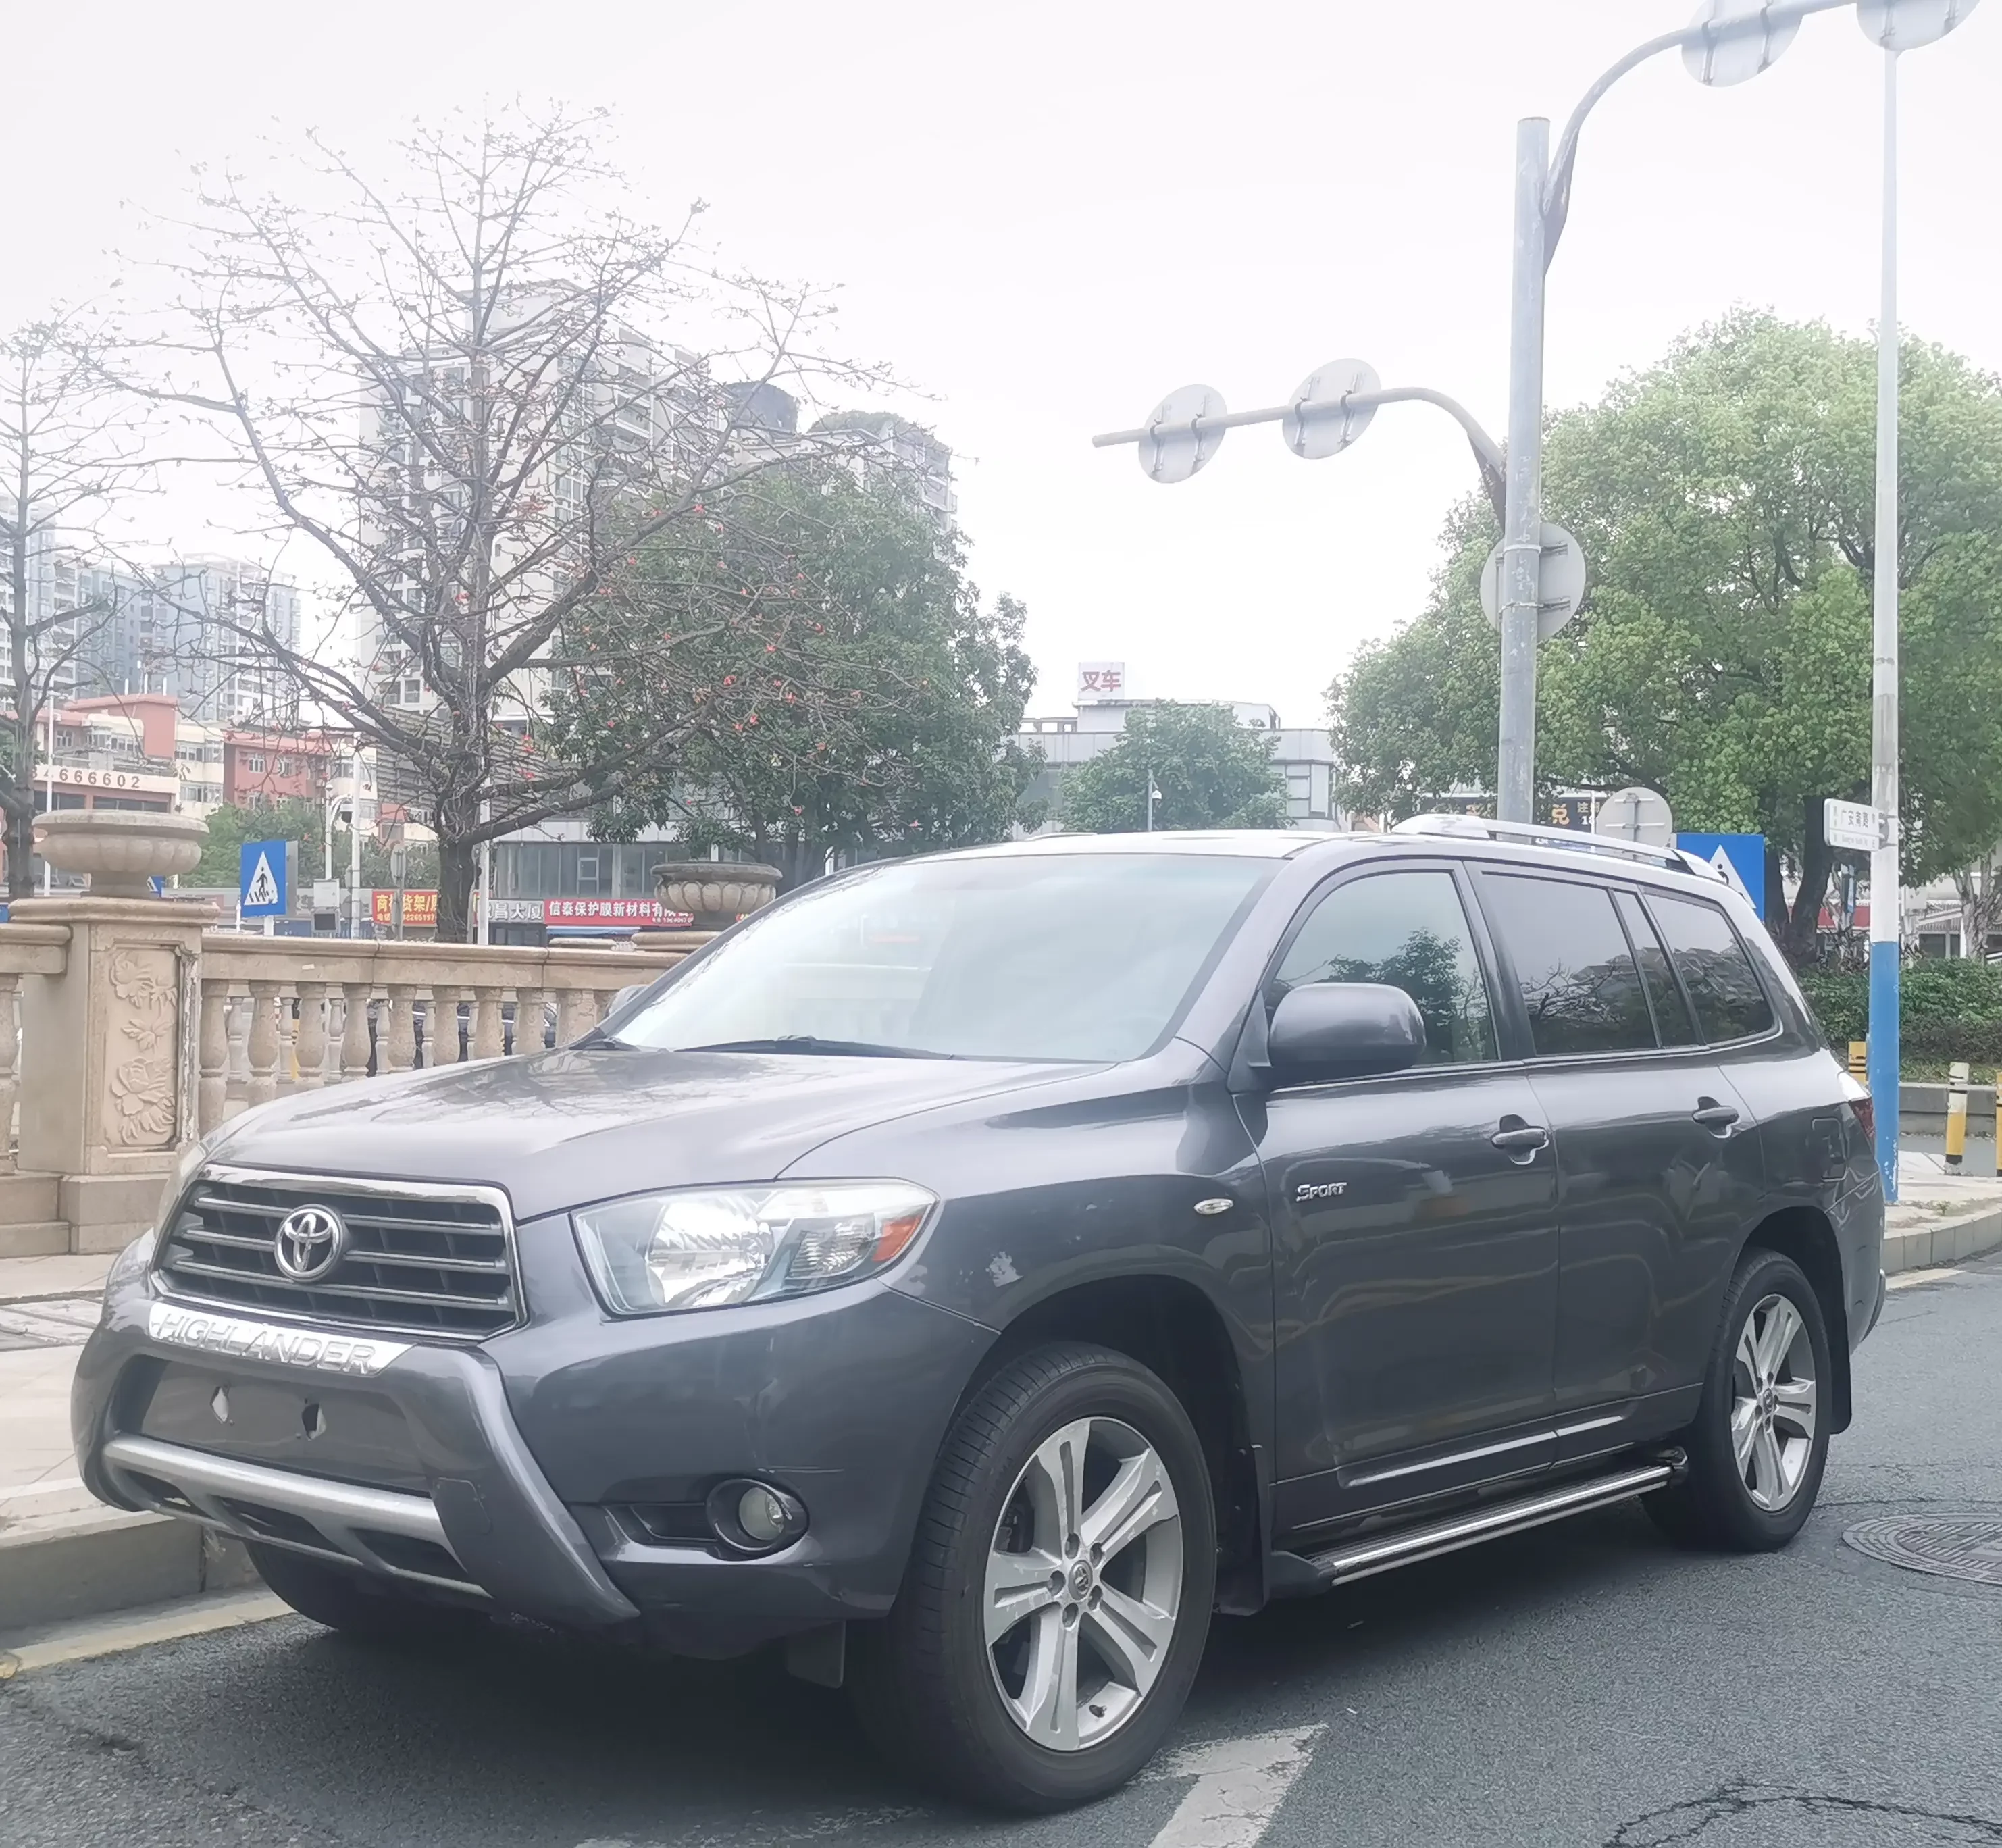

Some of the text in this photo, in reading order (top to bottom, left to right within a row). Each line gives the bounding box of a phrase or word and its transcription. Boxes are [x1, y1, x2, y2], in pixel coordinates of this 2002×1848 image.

[1081, 670, 1121, 692] 叉车
[549, 900, 689, 917] 信泰保护膜新材料有限
[157, 1312, 376, 1375] HIGHLANDER
